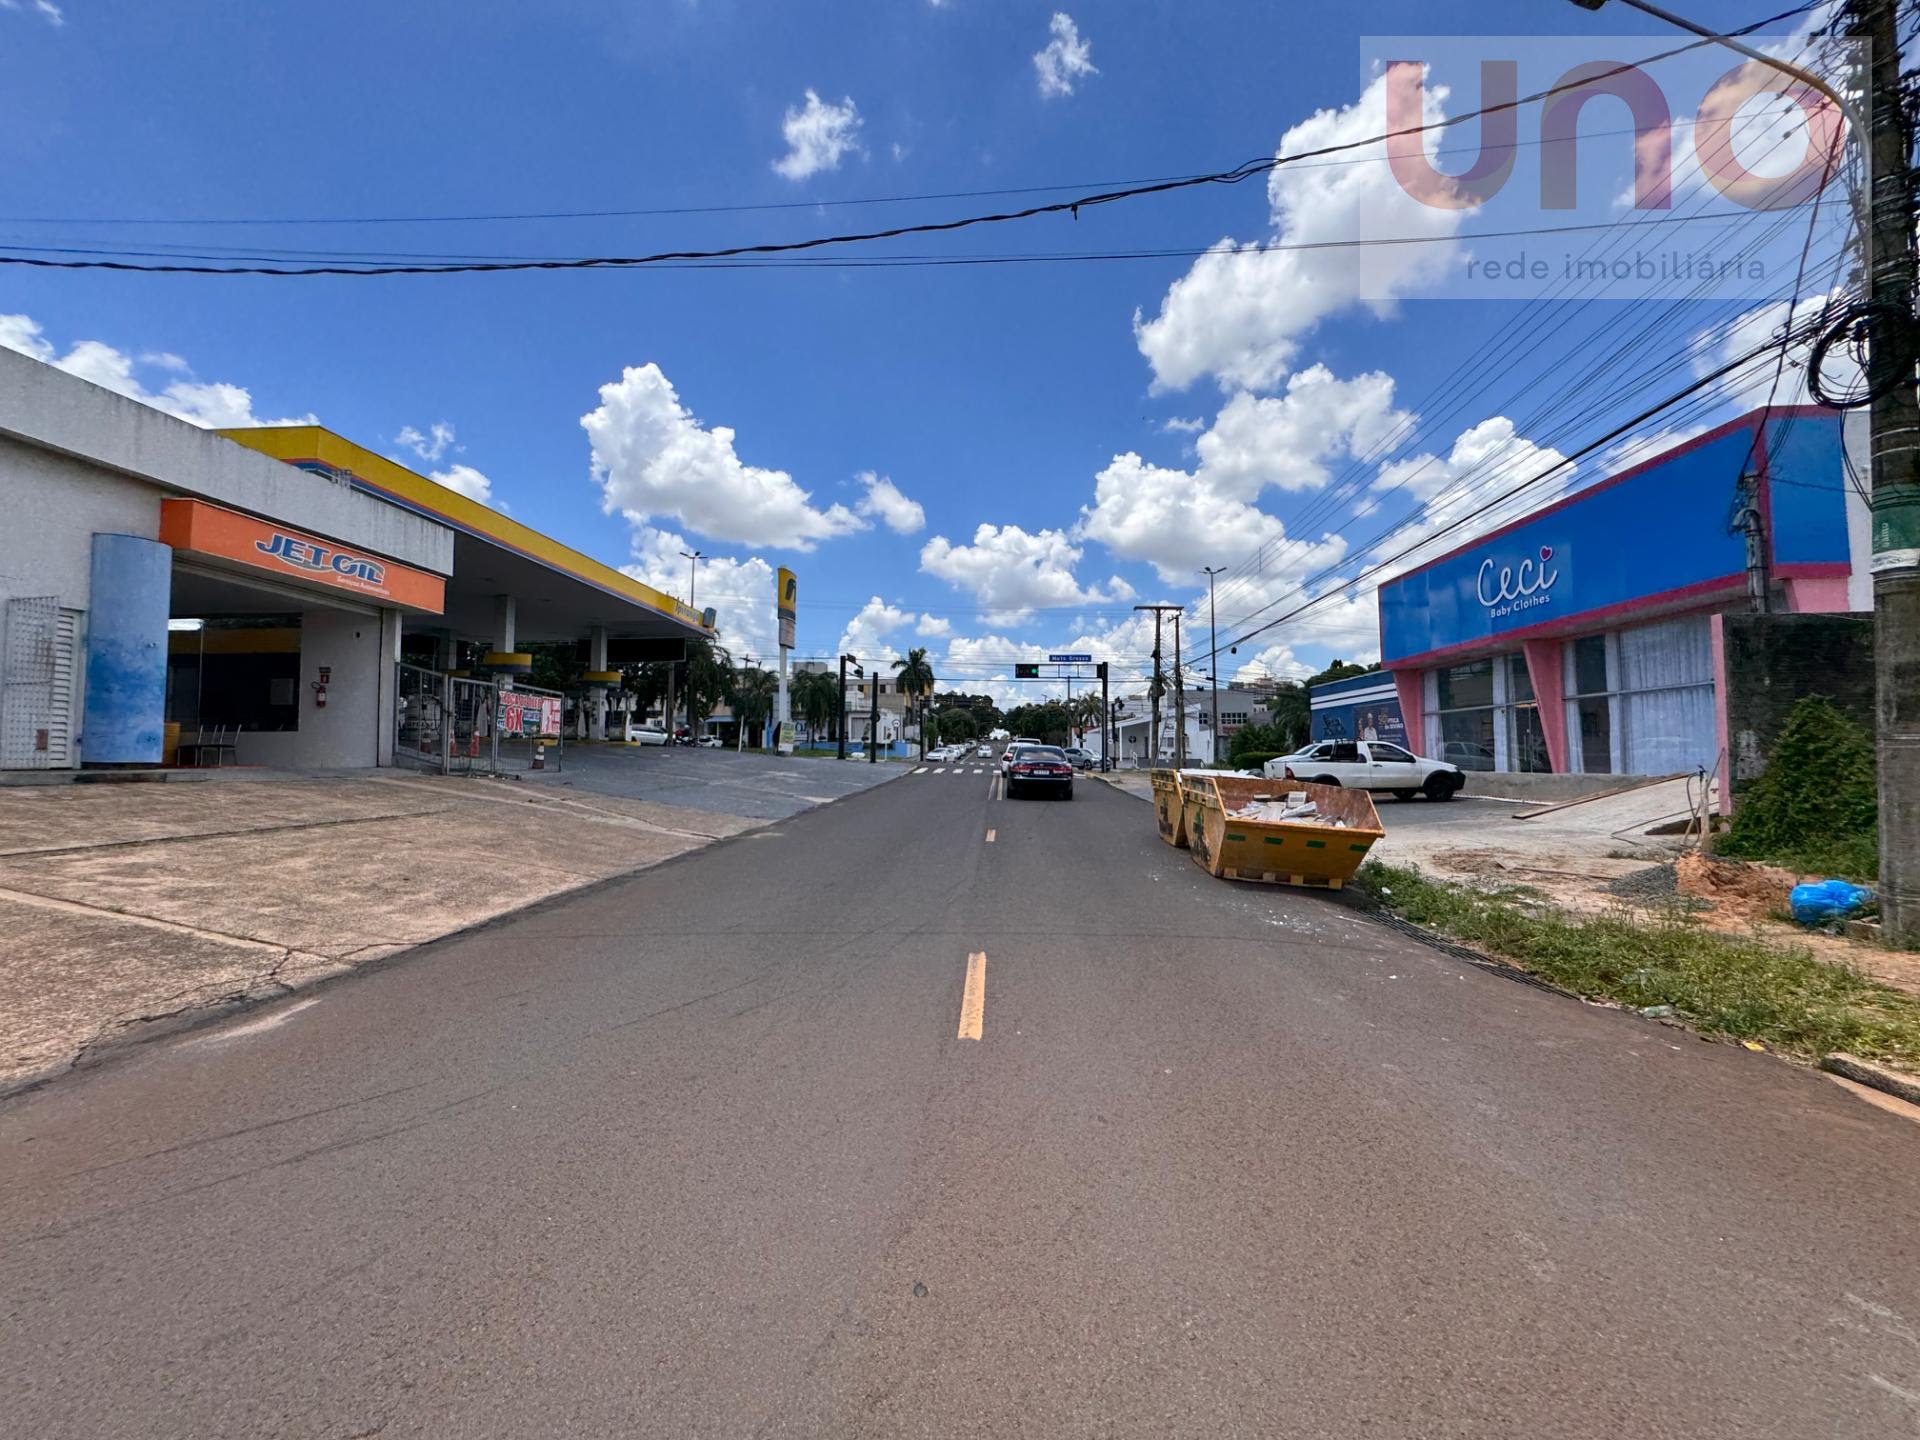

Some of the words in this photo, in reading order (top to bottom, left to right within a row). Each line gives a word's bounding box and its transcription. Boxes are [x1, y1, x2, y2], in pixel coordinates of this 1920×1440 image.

[256, 533, 331, 568] JET
[331, 553, 385, 585] OIL
[1477, 546, 1557, 606] Ceci
[1490, 606, 1511, 618] Baby
[1513, 595, 1550, 612] Clothes
